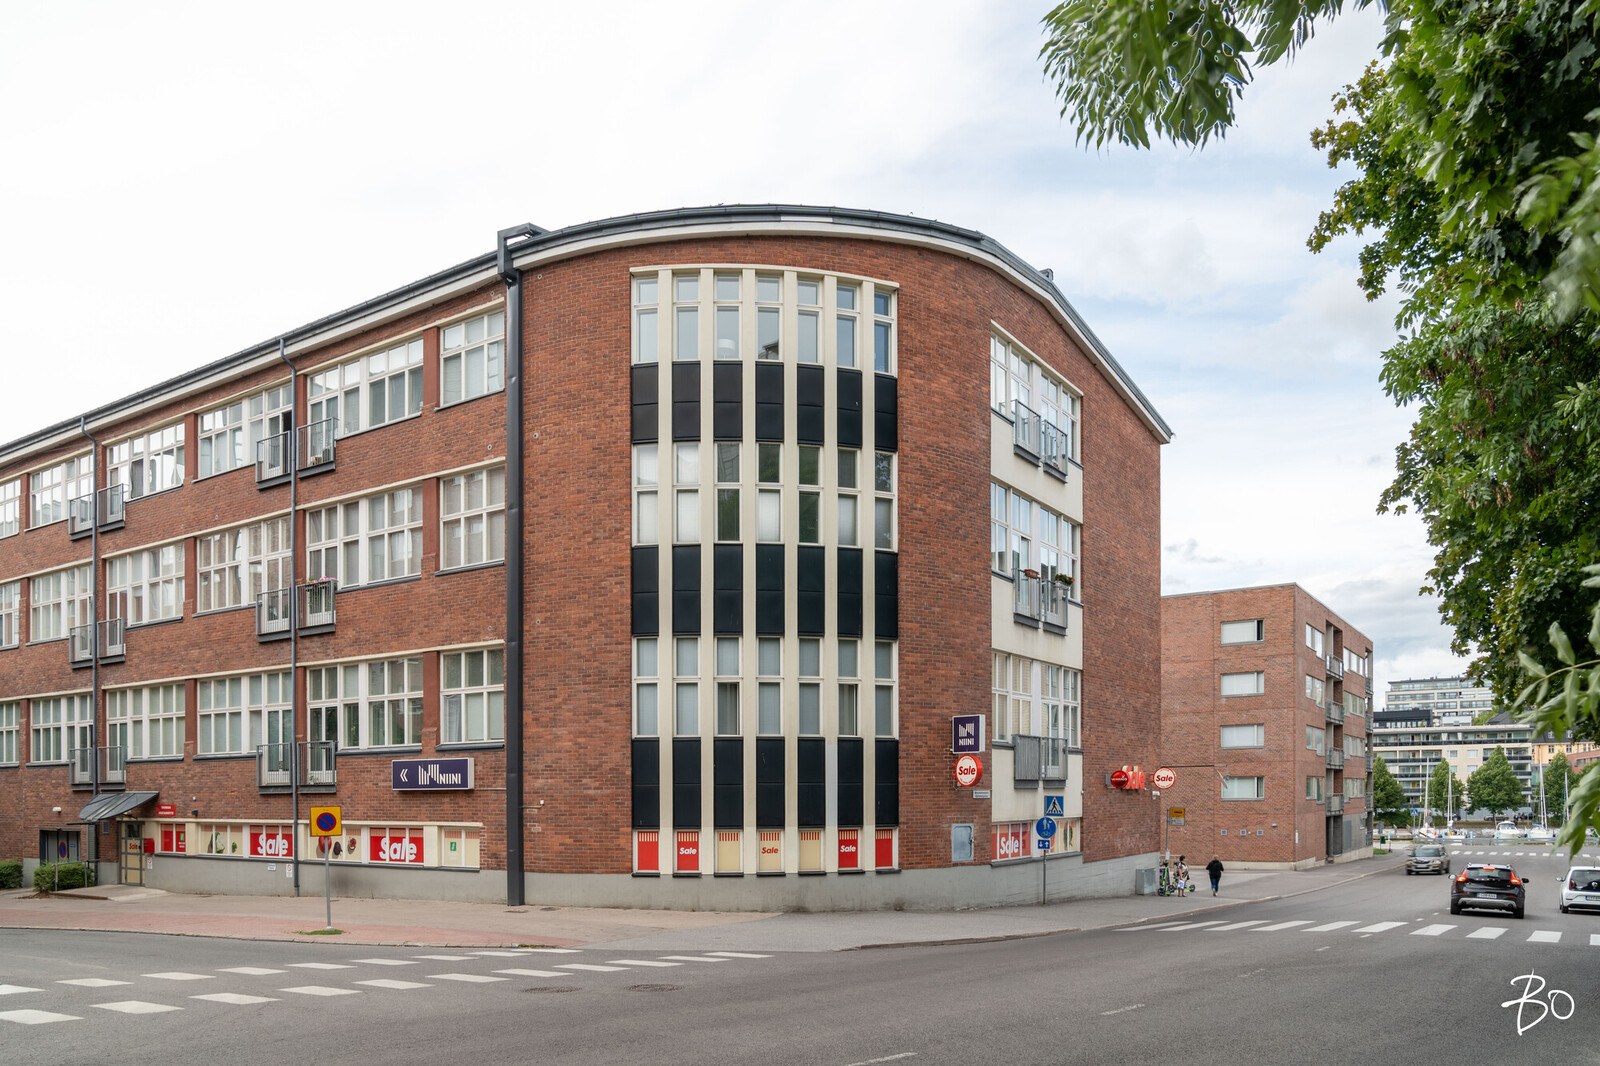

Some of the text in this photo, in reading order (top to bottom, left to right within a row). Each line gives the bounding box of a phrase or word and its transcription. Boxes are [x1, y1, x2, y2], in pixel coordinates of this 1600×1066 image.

[958, 738, 975, 746] NIINI
[958, 766, 976, 776] Sale
[440, 773, 461, 785] NIINI
[1122, 765, 1146, 790] Sale
[129, 842, 138, 850] Sale
[257, 834, 289, 855] Sale
[379, 837, 417, 861] Sale
[840, 845, 856, 853] Sale
[679, 847, 697, 855] Sale
[761, 846, 779, 854] Sale
